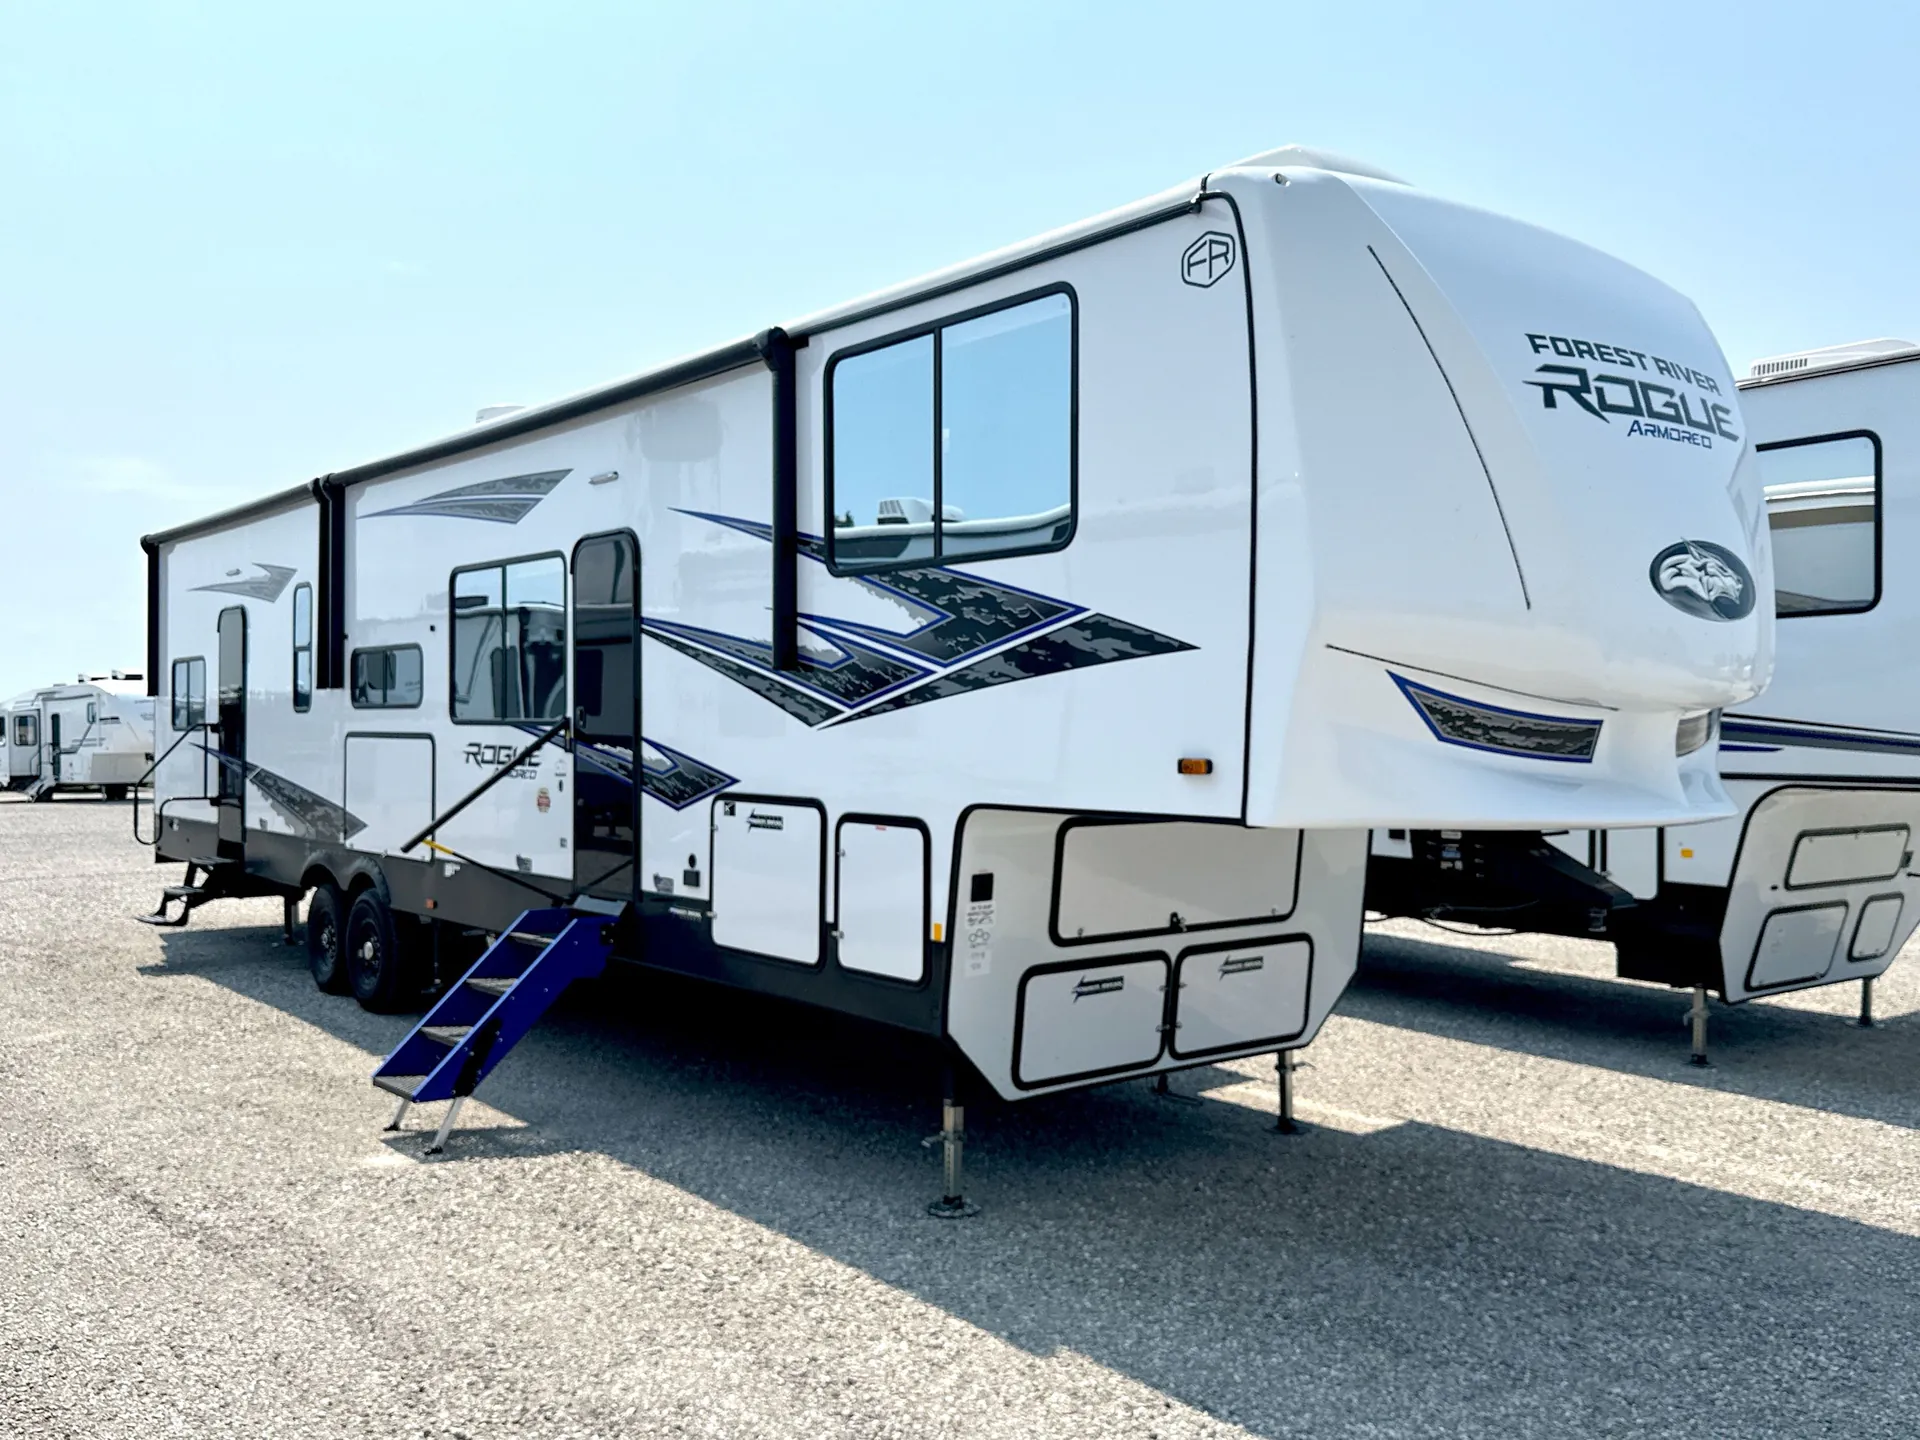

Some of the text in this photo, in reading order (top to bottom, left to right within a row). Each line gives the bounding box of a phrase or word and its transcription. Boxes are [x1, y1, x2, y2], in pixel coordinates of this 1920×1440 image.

[1524, 333, 1722, 396] FOREST RIVER
[1522, 363, 1740, 442] ROGUE
[1627, 420, 1712, 449] ARMORED
